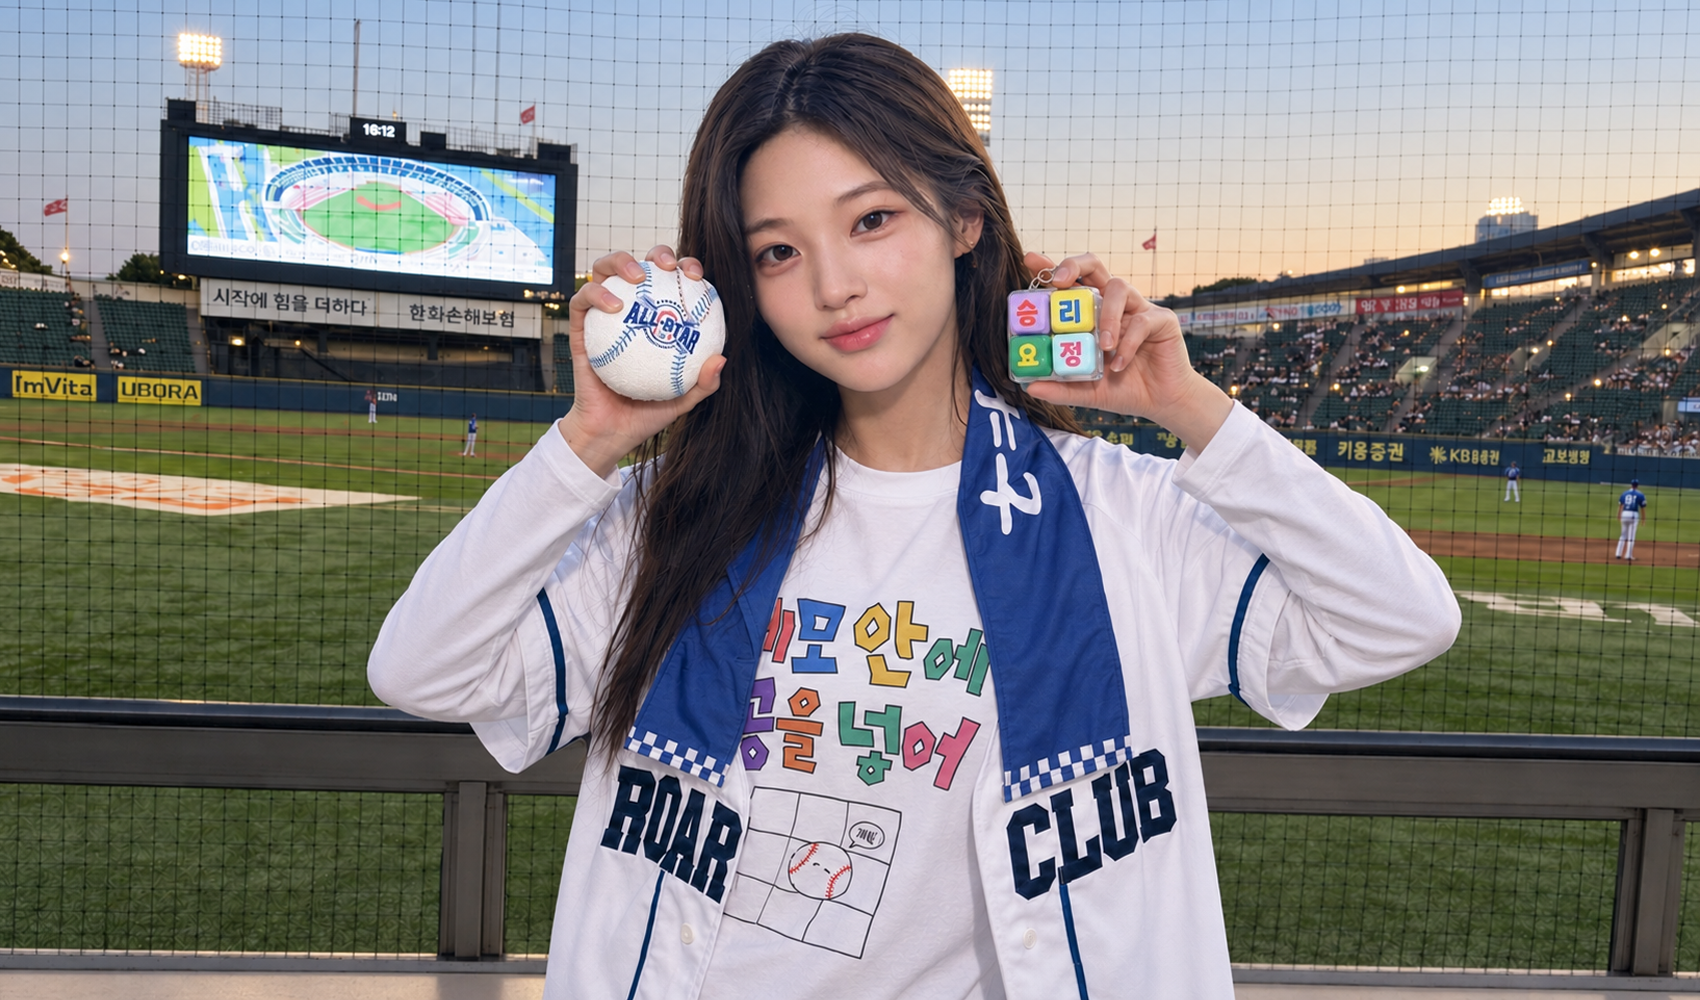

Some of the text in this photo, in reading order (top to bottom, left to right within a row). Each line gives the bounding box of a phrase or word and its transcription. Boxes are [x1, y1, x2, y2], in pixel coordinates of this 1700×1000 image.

[363, 123, 395, 138] 16:12
[213, 288, 367, 316] 시작에 힘을 더하다
[409, 303, 515, 328] 한화손해보험
[1016, 299, 1081, 328] 승리
[1017, 341, 1082, 367] 요정
[121, 381, 199, 400] UBORA
[853, 600, 990, 697] 안에
[838, 700, 981, 791] 넣어
[600, 748, 1177, 905] ROAR CLUB
